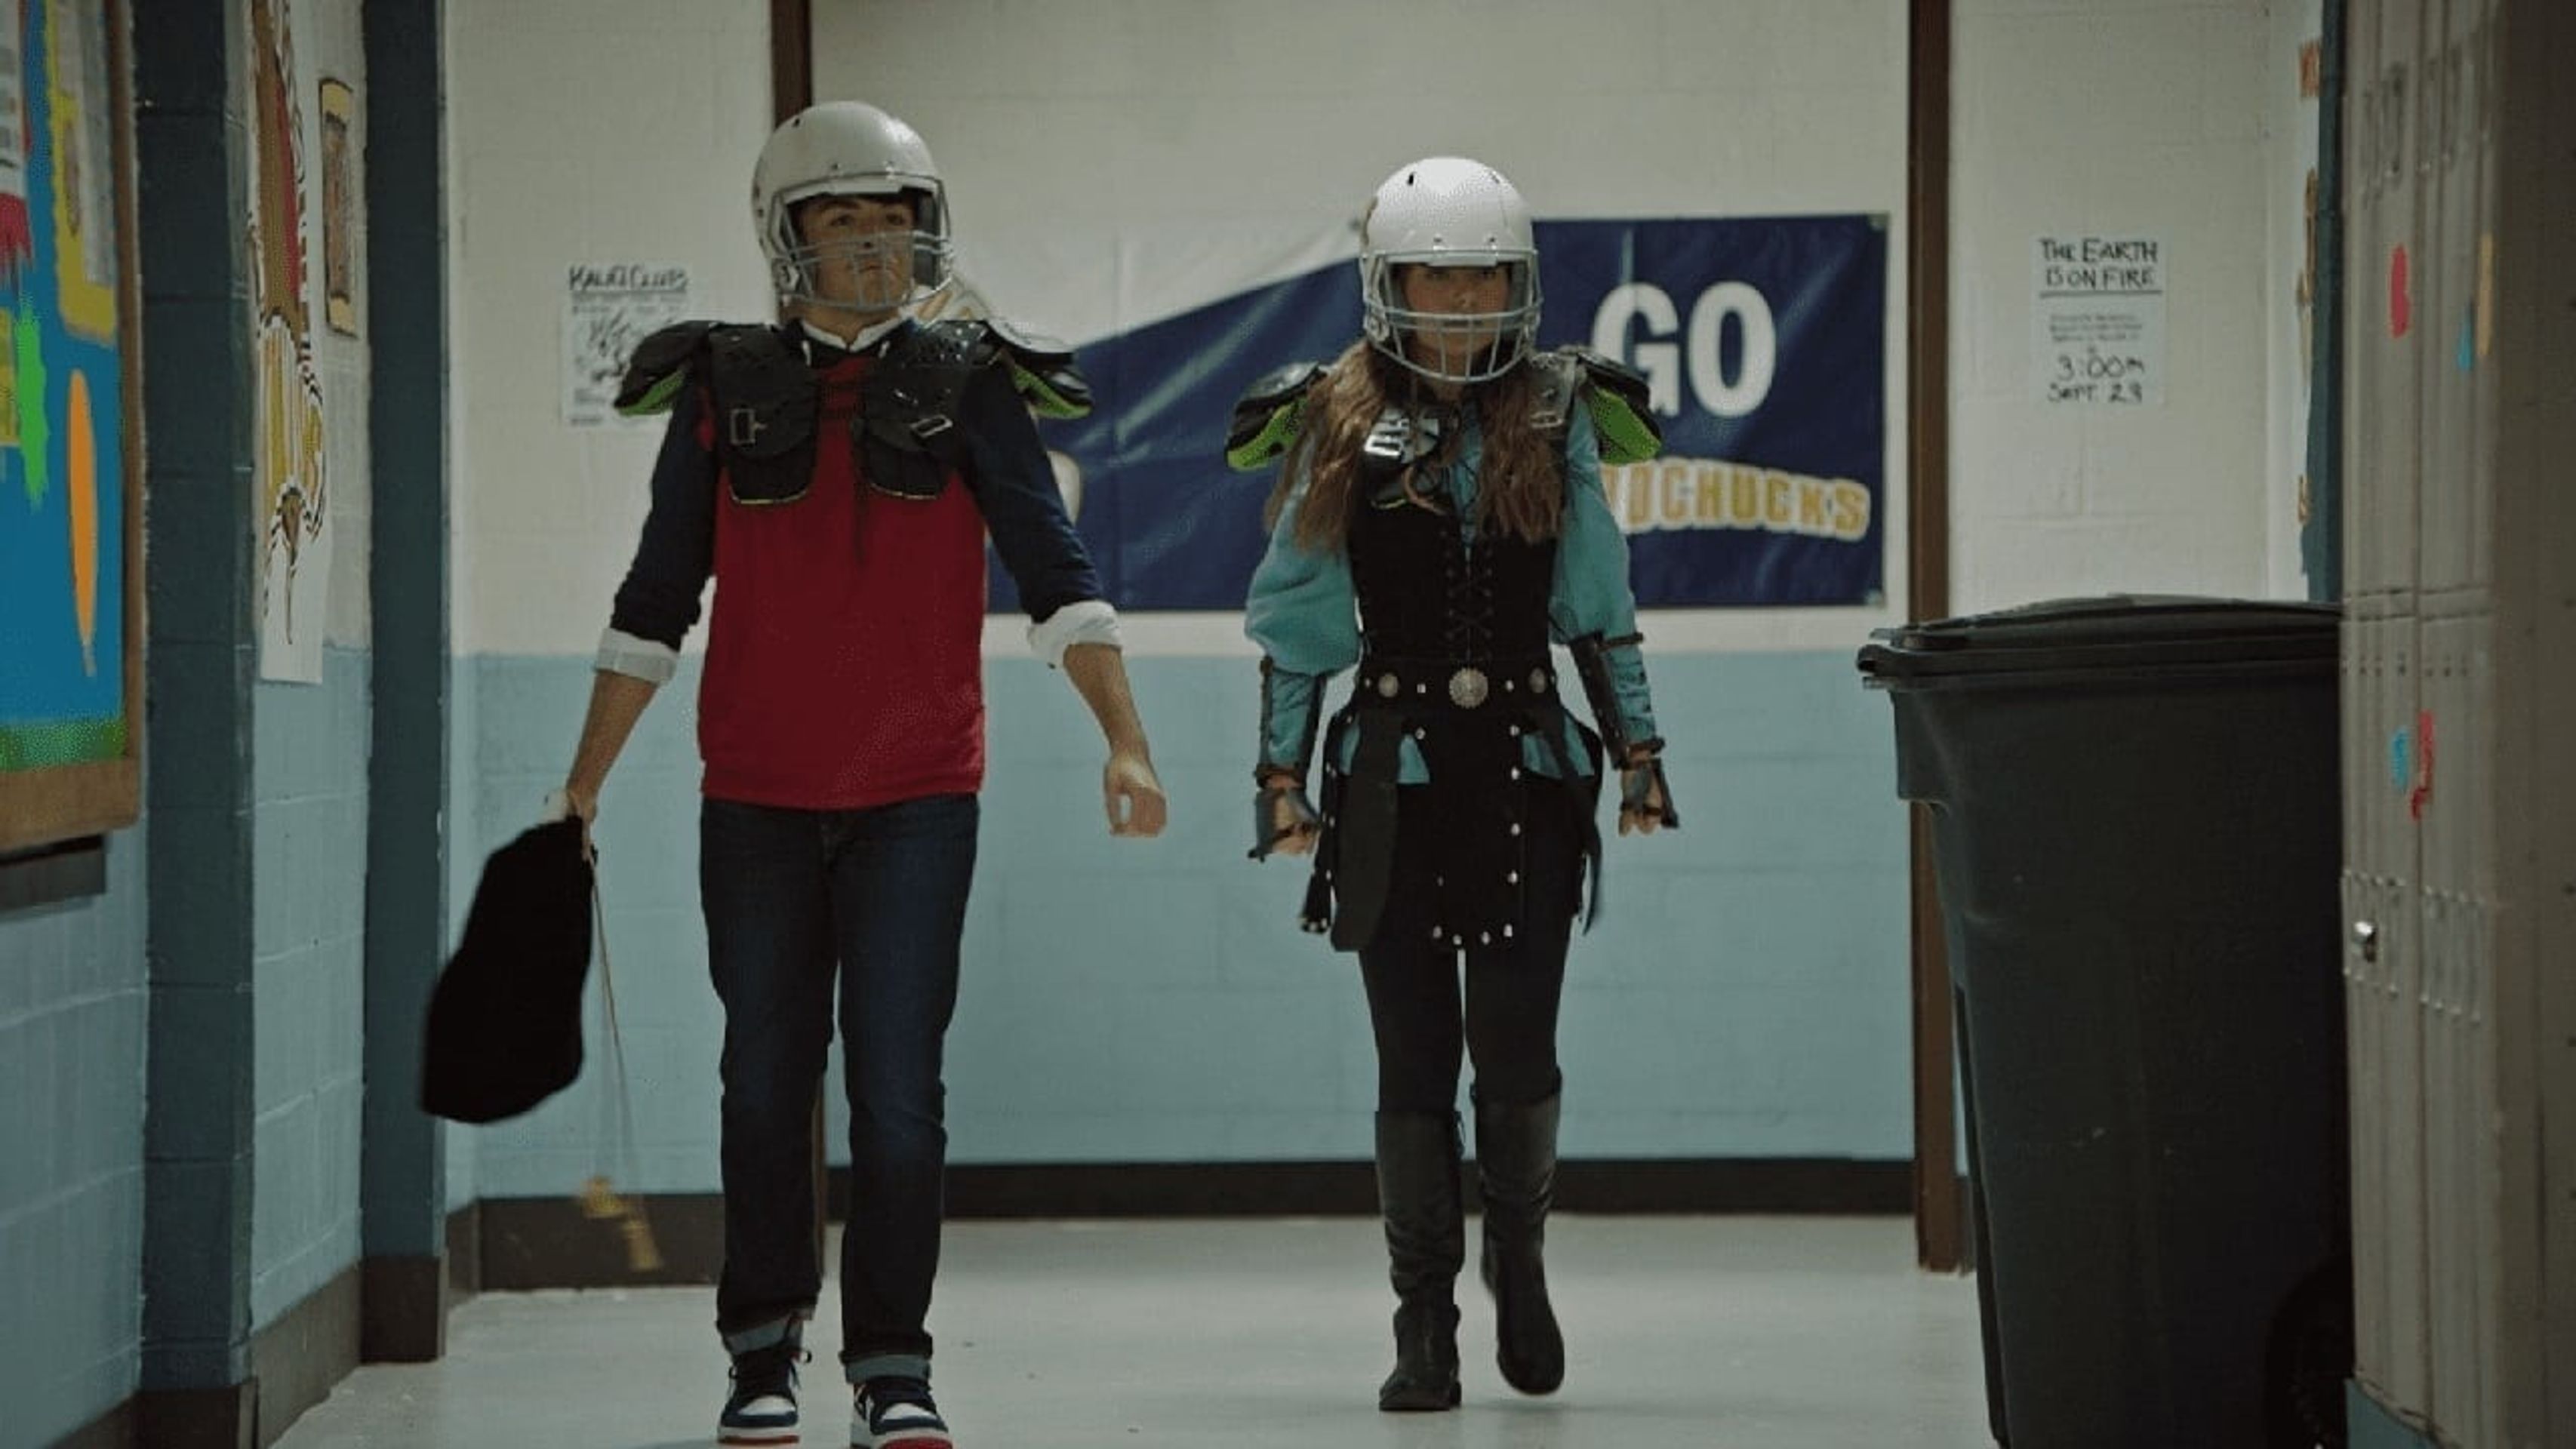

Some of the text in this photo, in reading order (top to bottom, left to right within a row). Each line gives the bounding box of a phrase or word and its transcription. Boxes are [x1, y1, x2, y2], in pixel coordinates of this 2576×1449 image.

[2039, 238, 2157, 263] THE EARTH
[2067, 268, 2096, 288] ON
[2103, 267, 2153, 288] FIRE
[1591, 281, 1777, 418] GO
